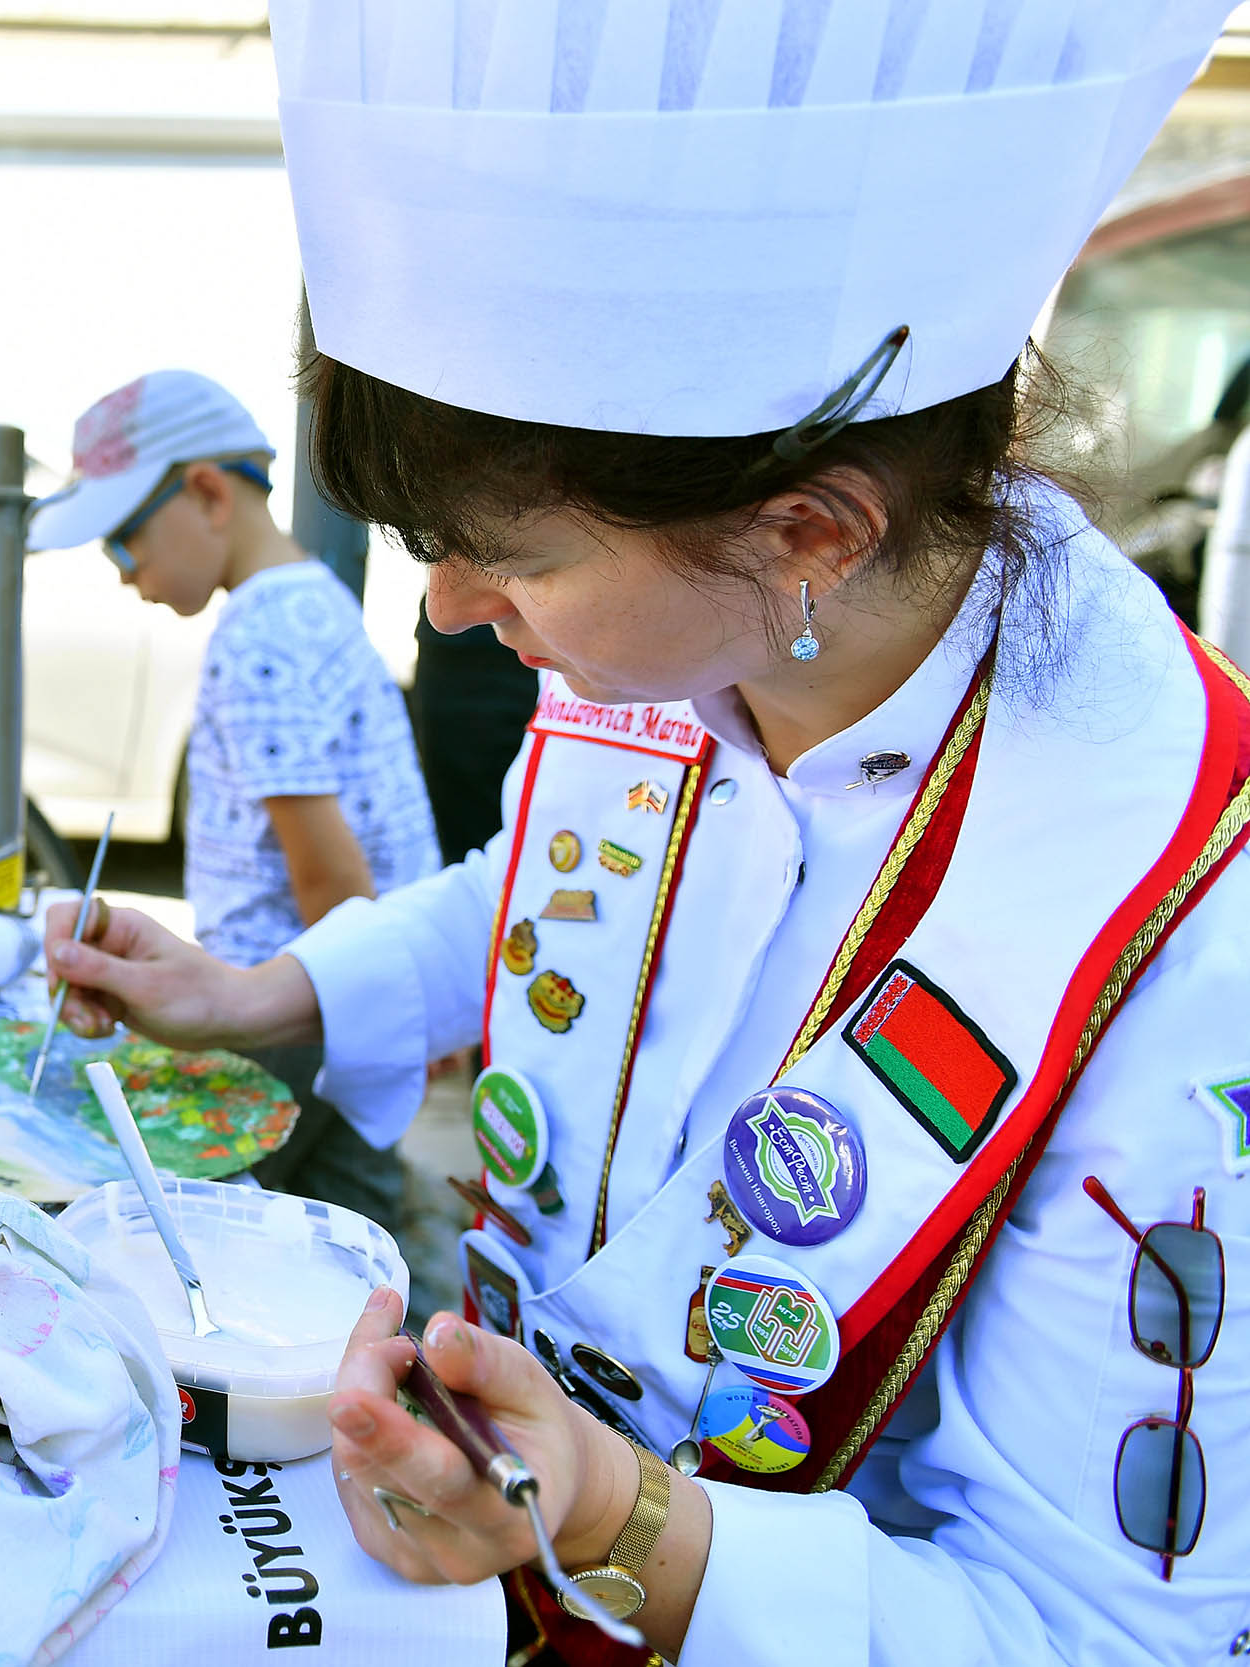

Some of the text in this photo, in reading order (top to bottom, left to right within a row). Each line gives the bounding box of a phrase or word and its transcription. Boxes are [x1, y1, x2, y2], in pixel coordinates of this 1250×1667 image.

[728, 1138, 754, 1184] Великий
[750, 1180, 782, 1236] Новгород
[711, 1301, 745, 1330] 25
[780, 1343, 799, 1360] 2018
